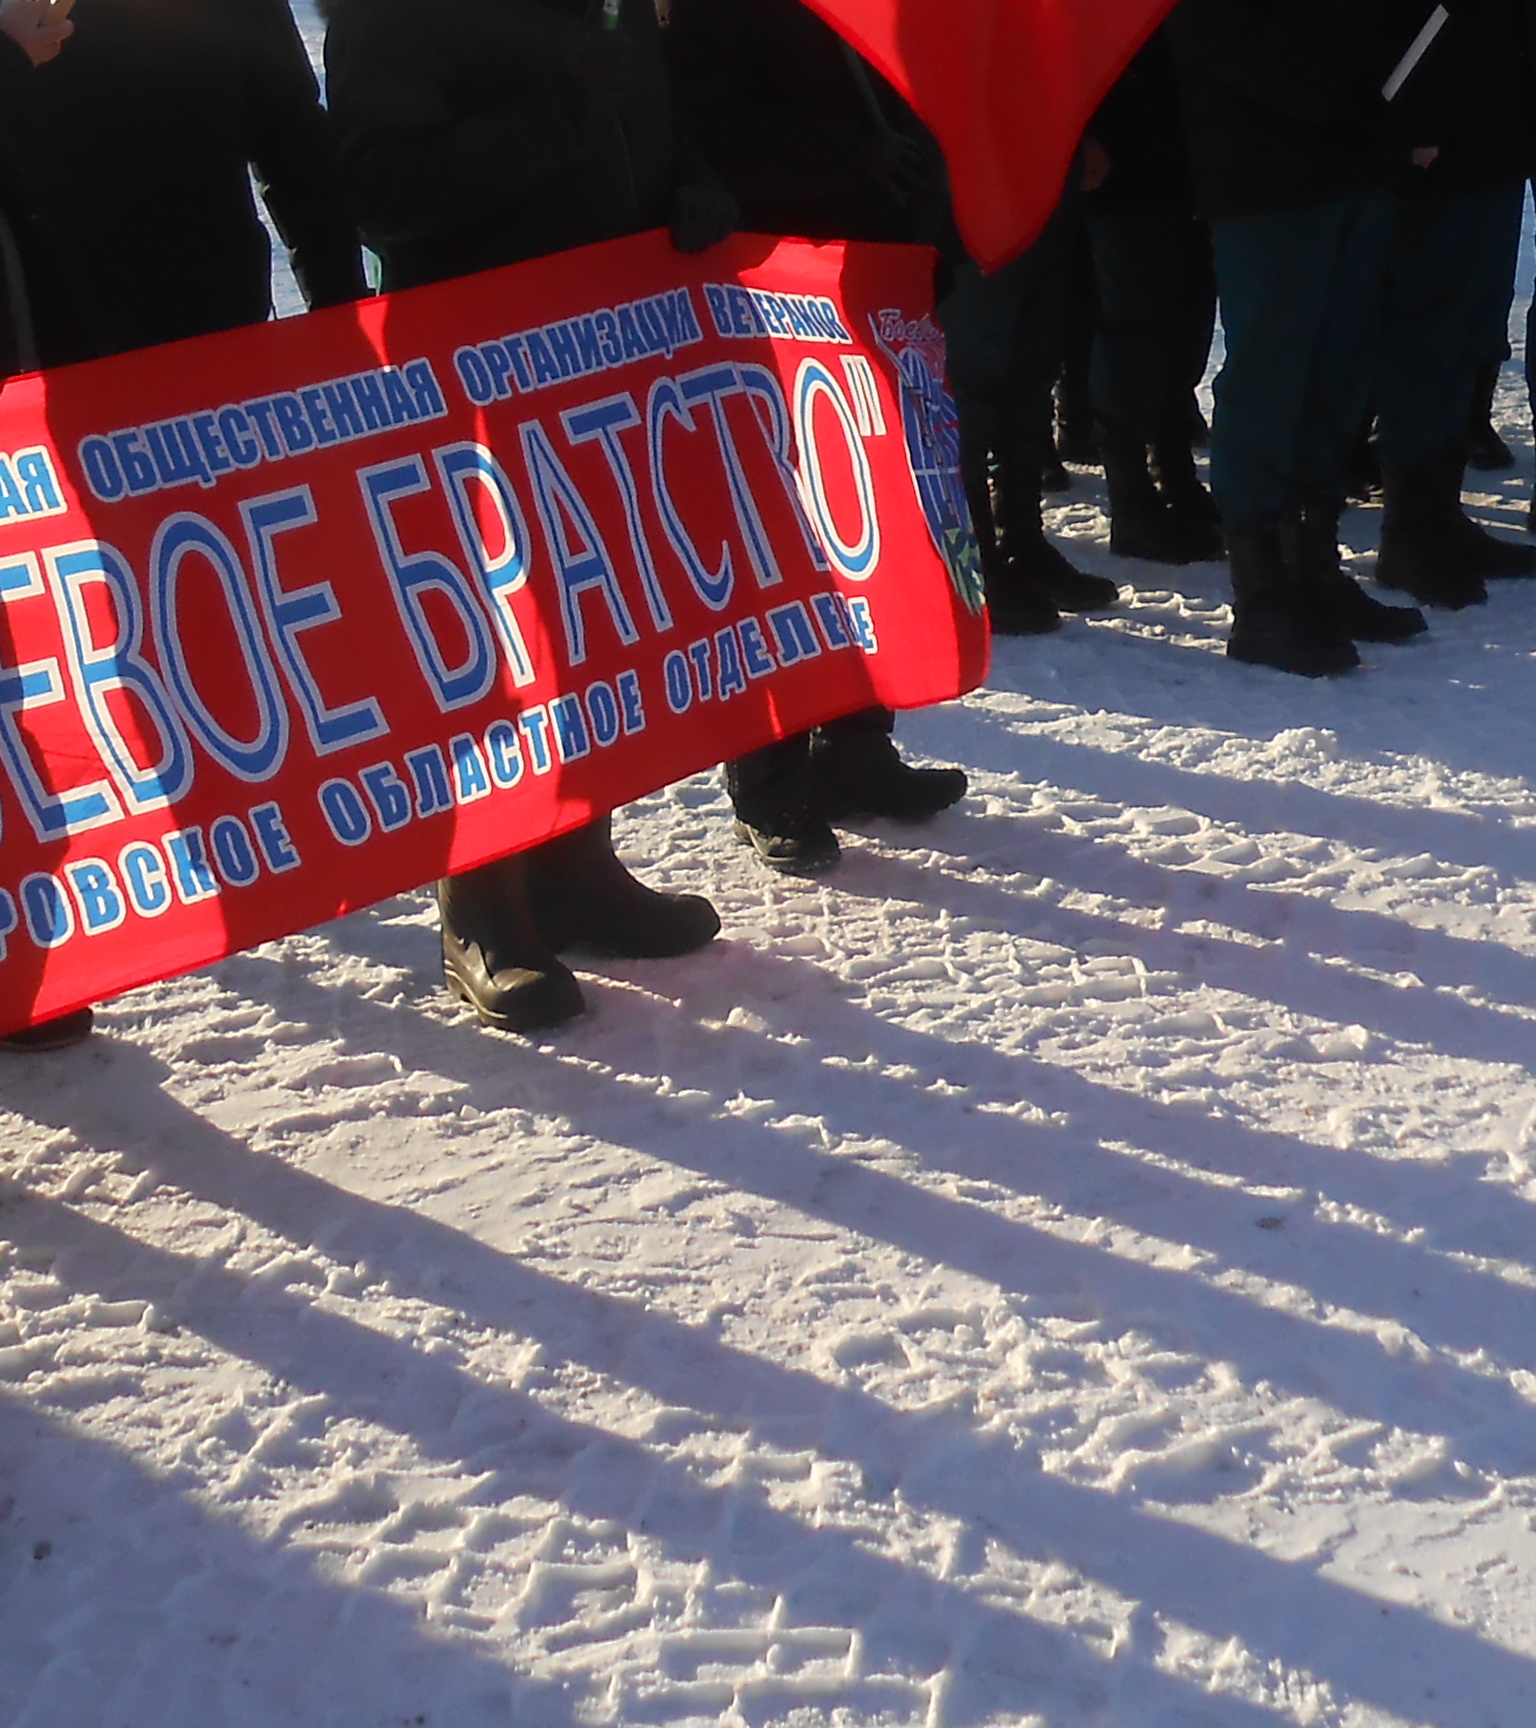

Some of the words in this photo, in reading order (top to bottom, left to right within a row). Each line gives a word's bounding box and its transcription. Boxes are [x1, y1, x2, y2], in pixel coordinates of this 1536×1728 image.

[78, 357, 447, 502] ОБЩЕСТВЕННАЯ
[453, 287, 698, 405] ОРГАНИЗАЦИЯ
[703, 283, 852, 344] ВЕТЕРАНОВ
[318, 669, 645, 847] ОБЛАСТНОЕ
